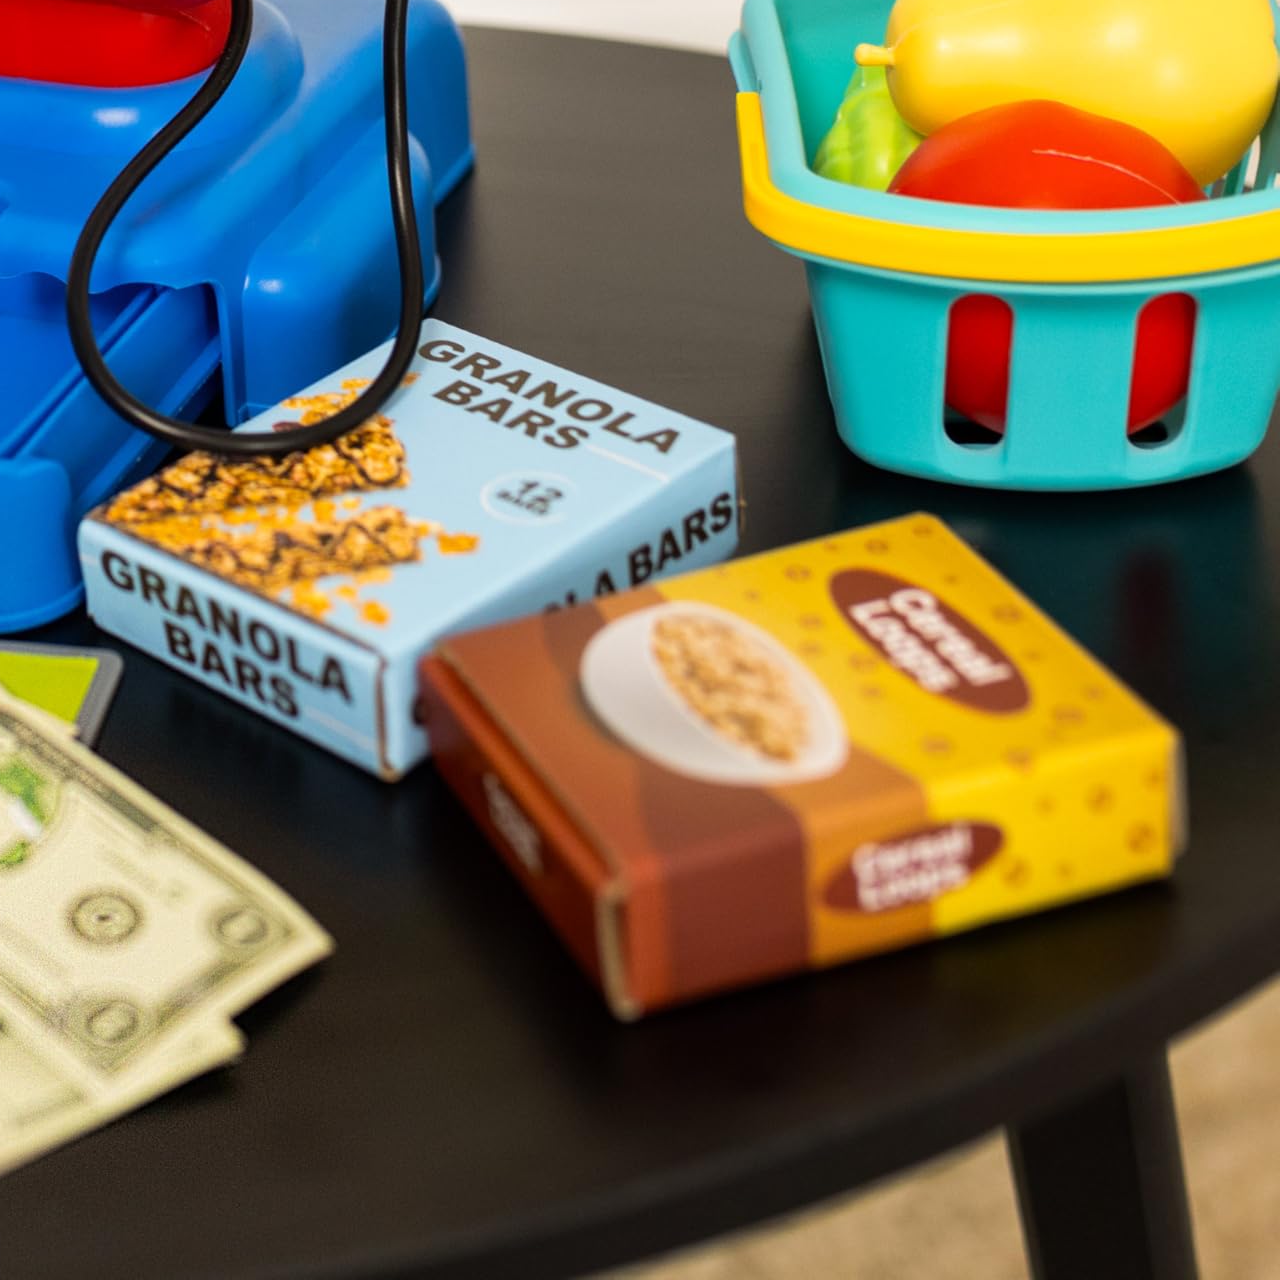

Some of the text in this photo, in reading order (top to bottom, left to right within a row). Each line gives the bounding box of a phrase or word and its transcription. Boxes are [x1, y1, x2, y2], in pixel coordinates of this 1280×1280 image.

[418, 339, 681, 454] GRANOLA
[432, 379, 590, 449] BARS
[627, 491, 734, 588] BARS
[102, 549, 353, 705] GRANOLA
[164, 620, 300, 718] BARS
